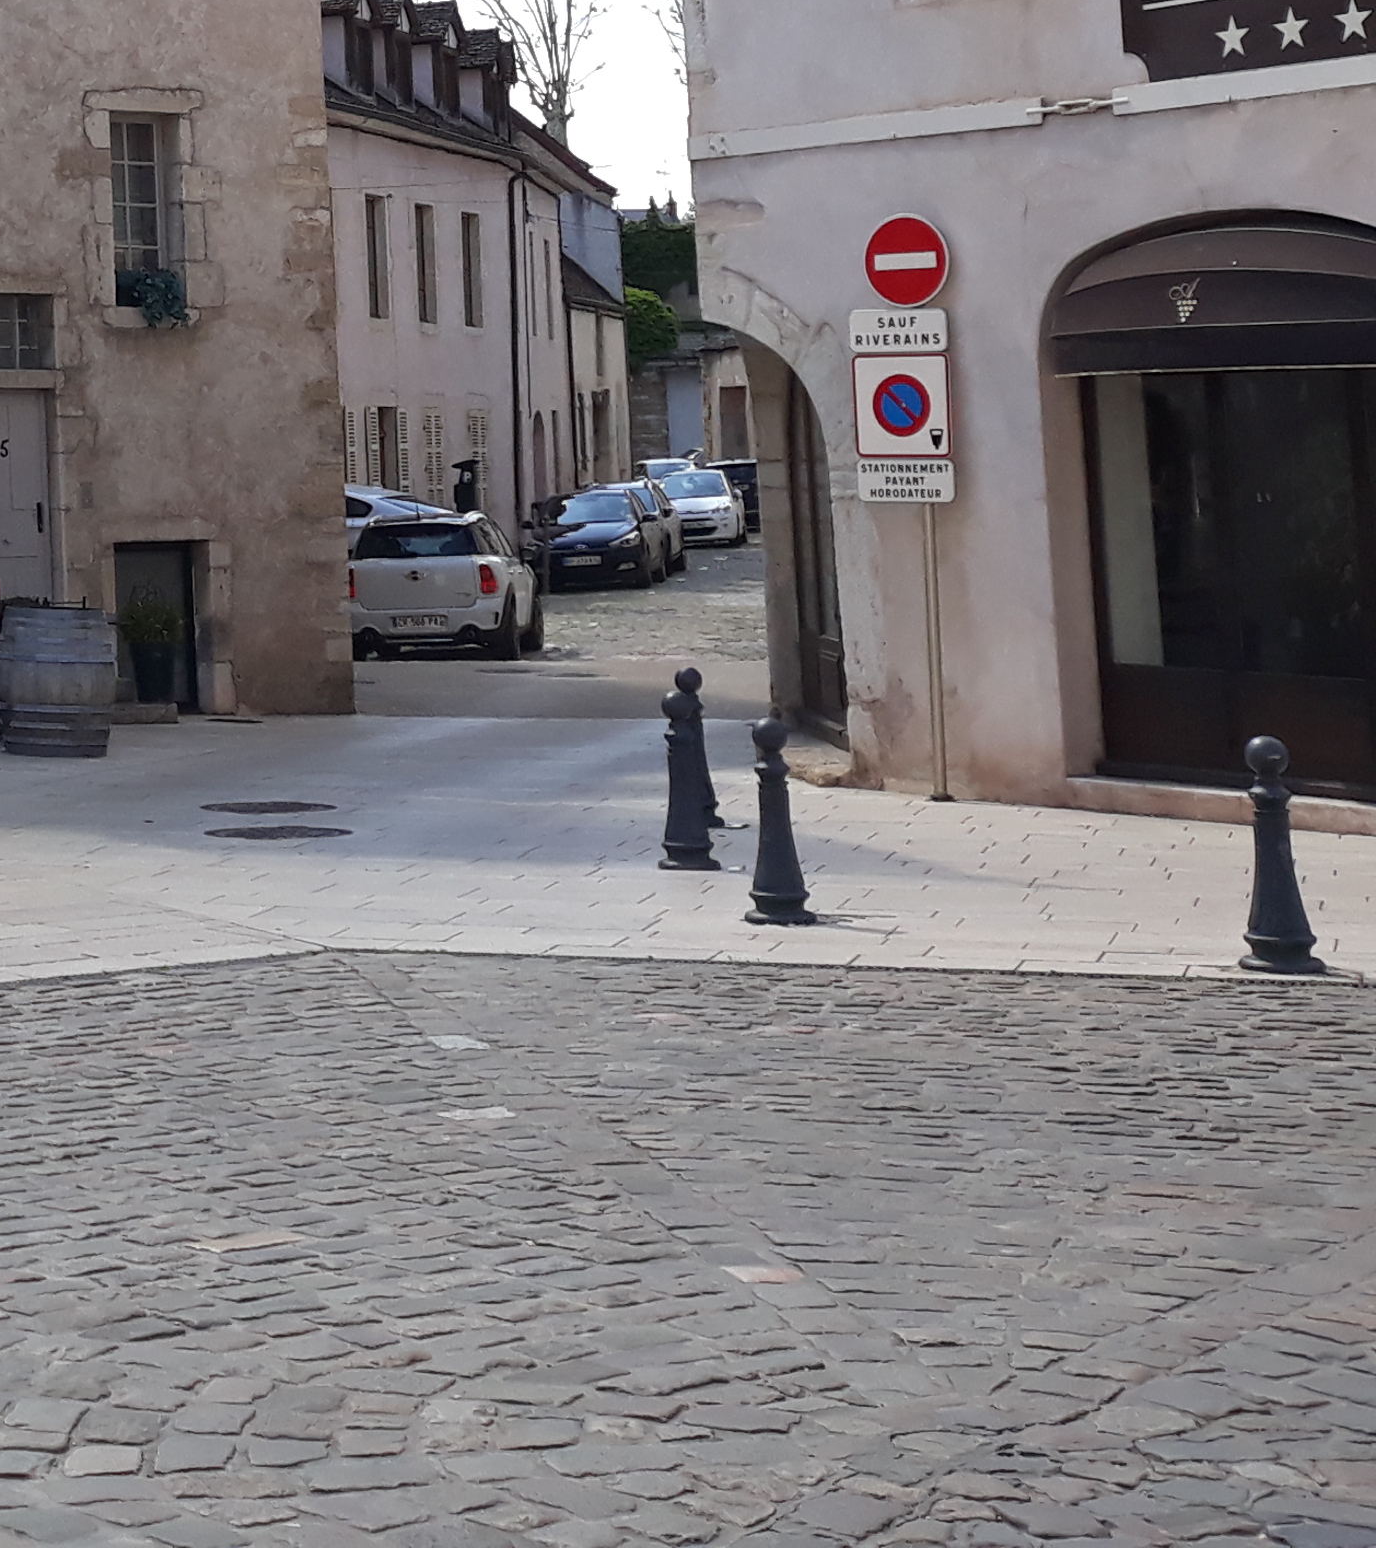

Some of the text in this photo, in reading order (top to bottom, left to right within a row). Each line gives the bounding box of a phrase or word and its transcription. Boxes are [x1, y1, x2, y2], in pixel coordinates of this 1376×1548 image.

[878, 316, 918, 328] SAUF
[855, 333, 941, 346] RIVERAINS
[0, 439, 9, 458] 5
[860, 463, 950, 474] STATIONNEMENT
[885, 476, 925, 486] PAYANT
[870, 488, 942, 499] HORODATEUR
